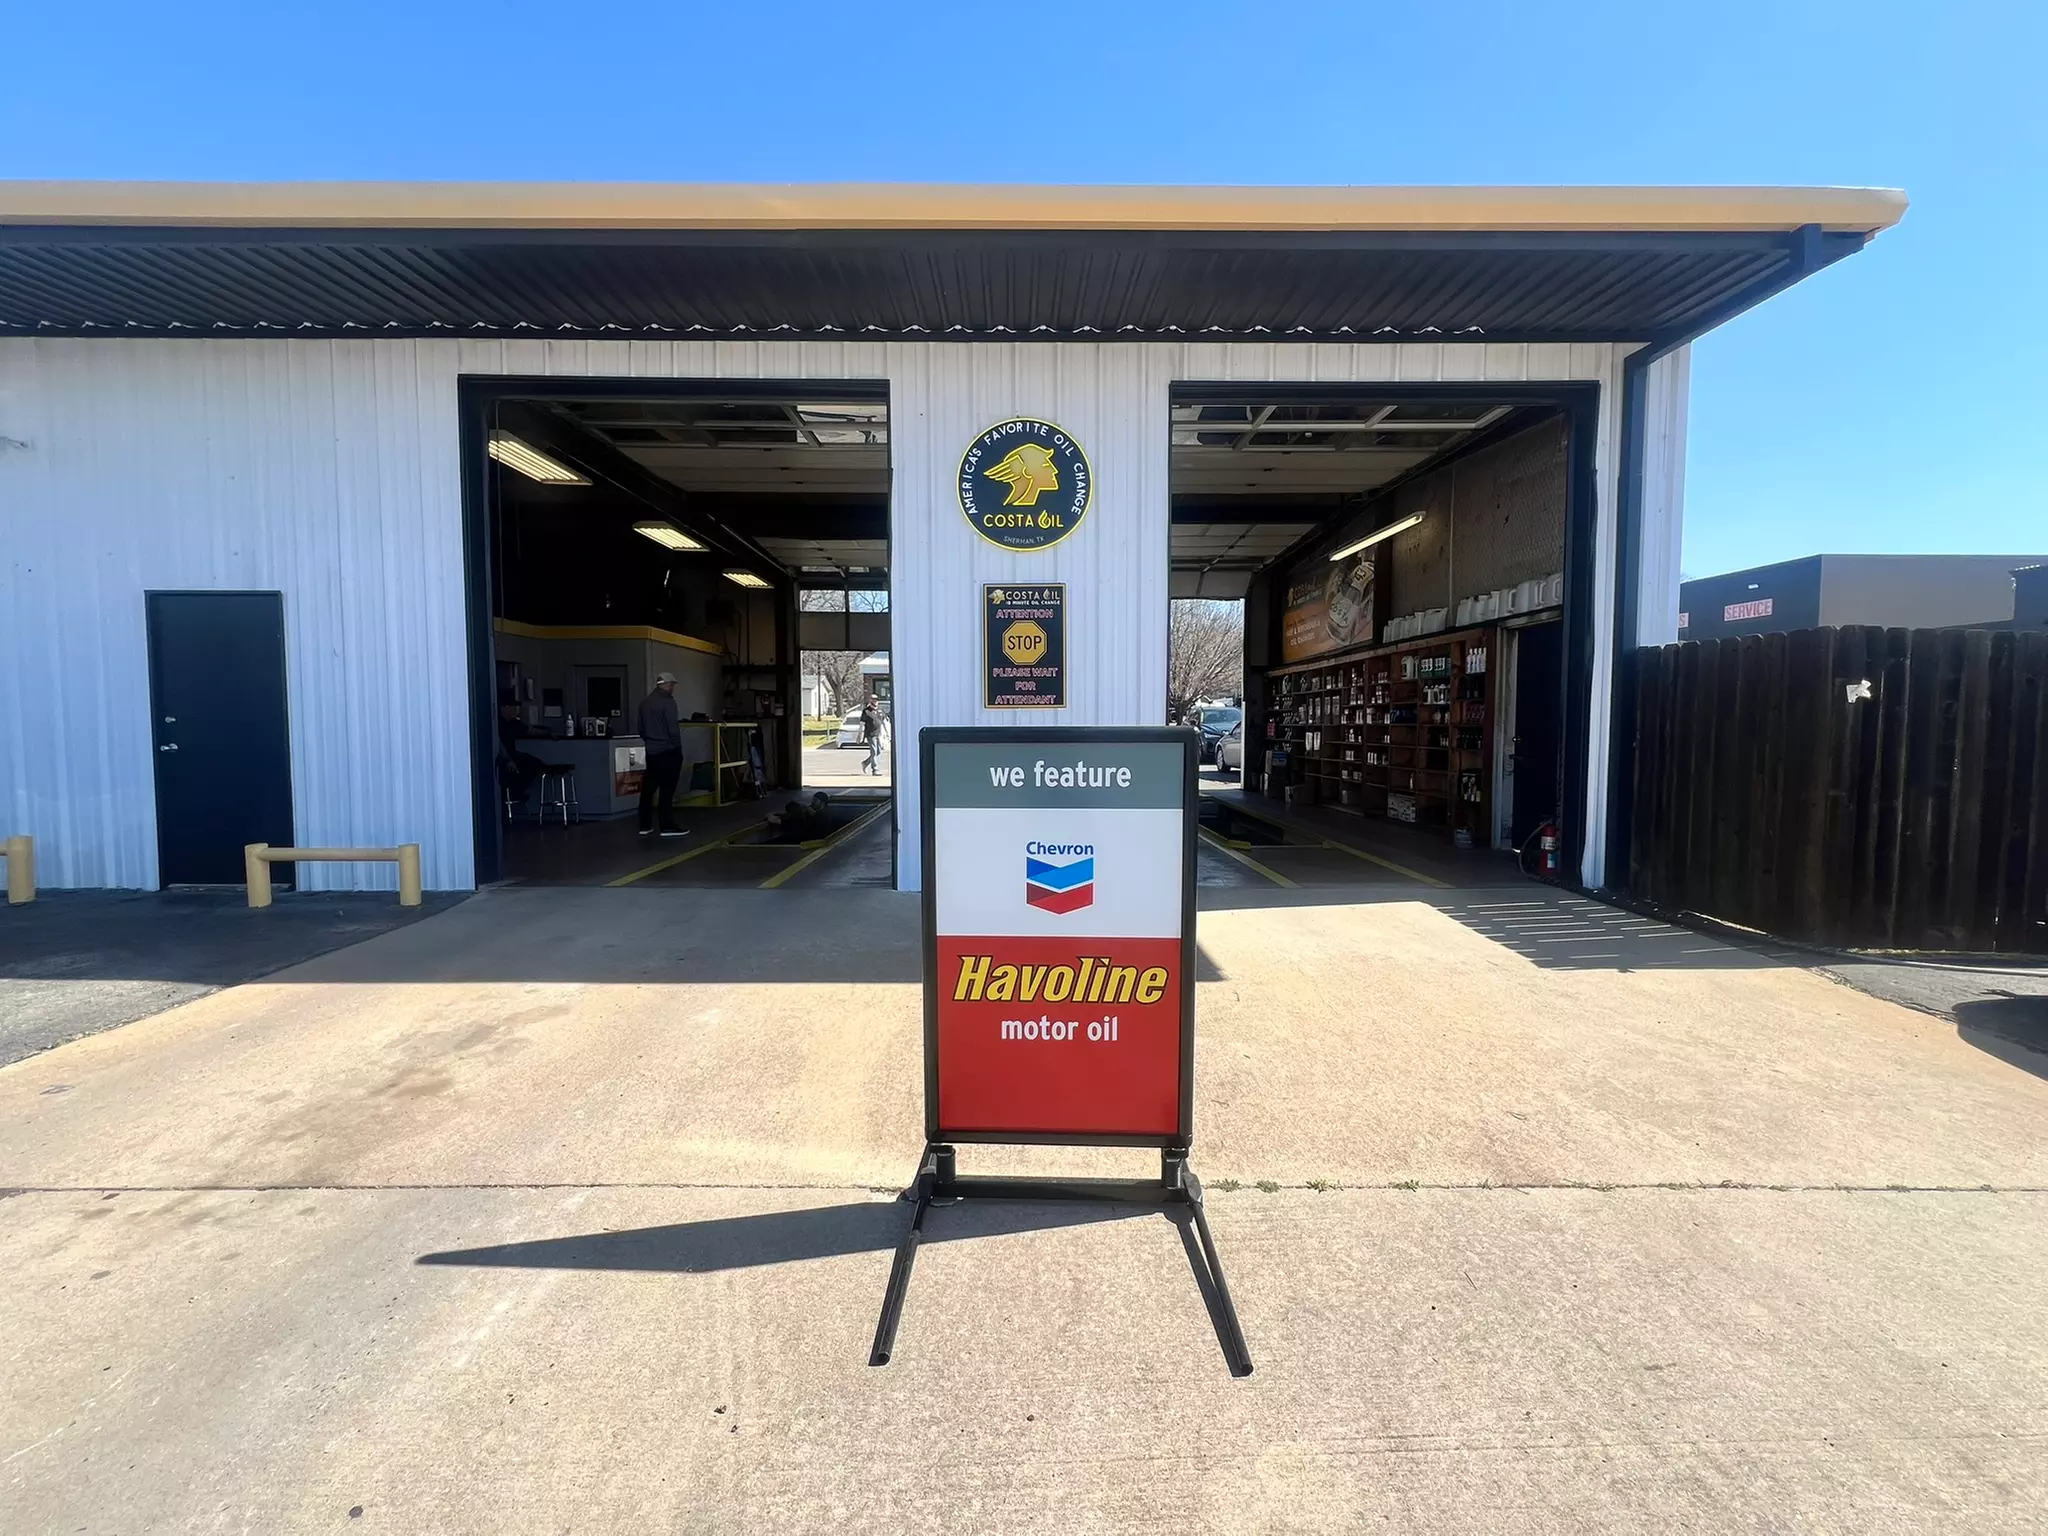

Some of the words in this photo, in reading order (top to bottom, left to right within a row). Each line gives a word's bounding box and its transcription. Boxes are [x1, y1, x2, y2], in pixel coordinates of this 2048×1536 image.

[962, 447, 982, 515] AMERICA'S
[984, 422, 1049, 446] FAVORITE
[1054, 434, 1075, 457] OIL
[1072, 462, 1087, 515] CHANGE
[983, 513, 1034, 528] COSTA
[1038, 510, 1064, 529] OIL
[1005, 591, 1040, 601] COSTA
[1042, 588, 1060, 601] OIL
[996, 609, 1054, 619] ATTENTION
[1726, 601, 1771, 620] SERVICE
[1007, 635, 1042, 651] STOP
[992, 667, 1031, 678] PLEASE
[1032, 667, 1059, 677] WAIT
[1015, 681, 1036, 691] FOR
[995, 695, 1056, 705] ATTENDANT
[989, 766, 1025, 788] we
[1033, 760, 1132, 788] feature
[1025, 840, 1094, 856] Chevron
[952, 955, 1169, 1004] Havoline
[1001, 1015, 1079, 1040] motor
[1087, 1015, 1119, 1041] oil
